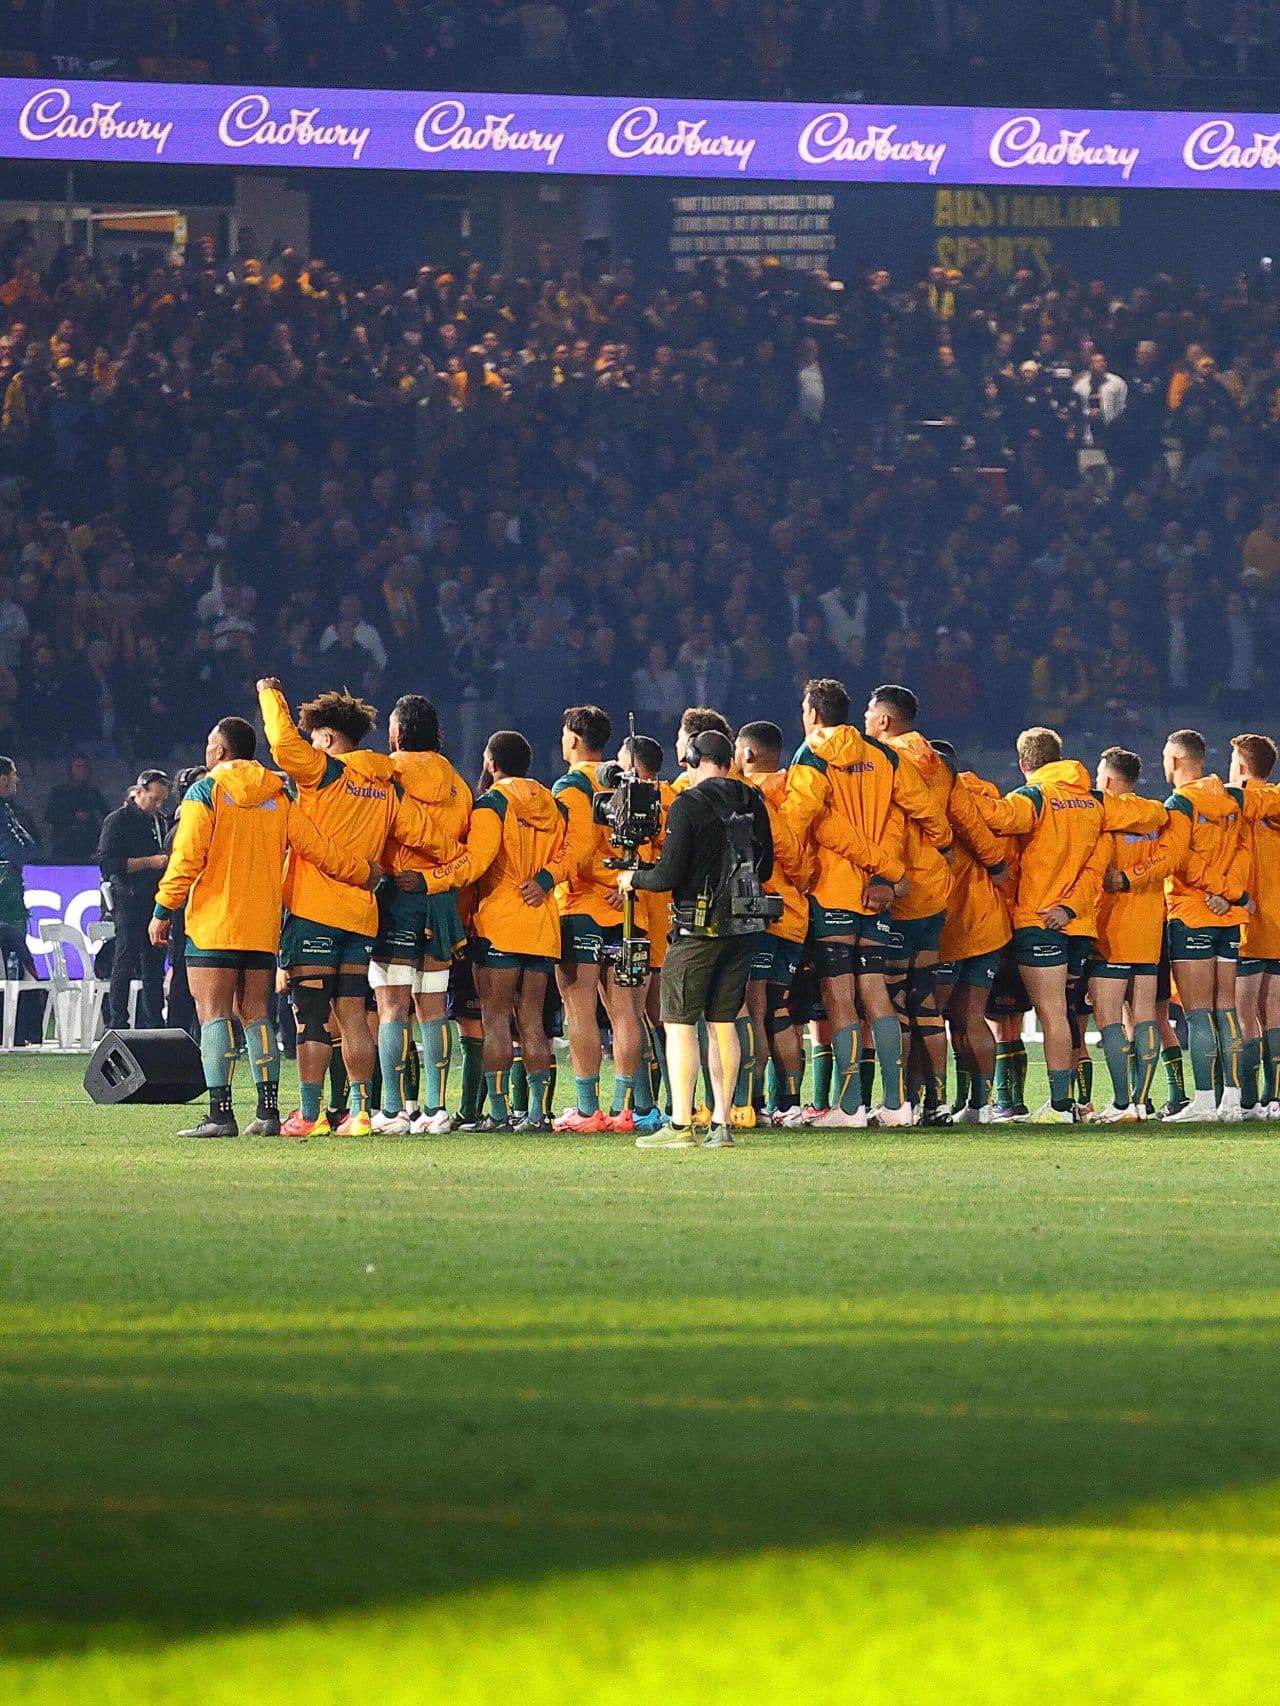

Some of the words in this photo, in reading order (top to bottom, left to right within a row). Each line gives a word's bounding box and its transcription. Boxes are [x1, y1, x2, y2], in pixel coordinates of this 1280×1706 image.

[20, 88, 173, 155] Cadbury
[218, 94, 371, 160] Cadbury
[414, 100, 565, 165] Cadbury
[607, 106, 756, 171] Cadbury
[797, 112, 947, 175] Cadbury
[989, 116, 1140, 179] Cadbury
[345, 780, 386, 800] Santos
[1050, 797, 1095, 811] Santos
